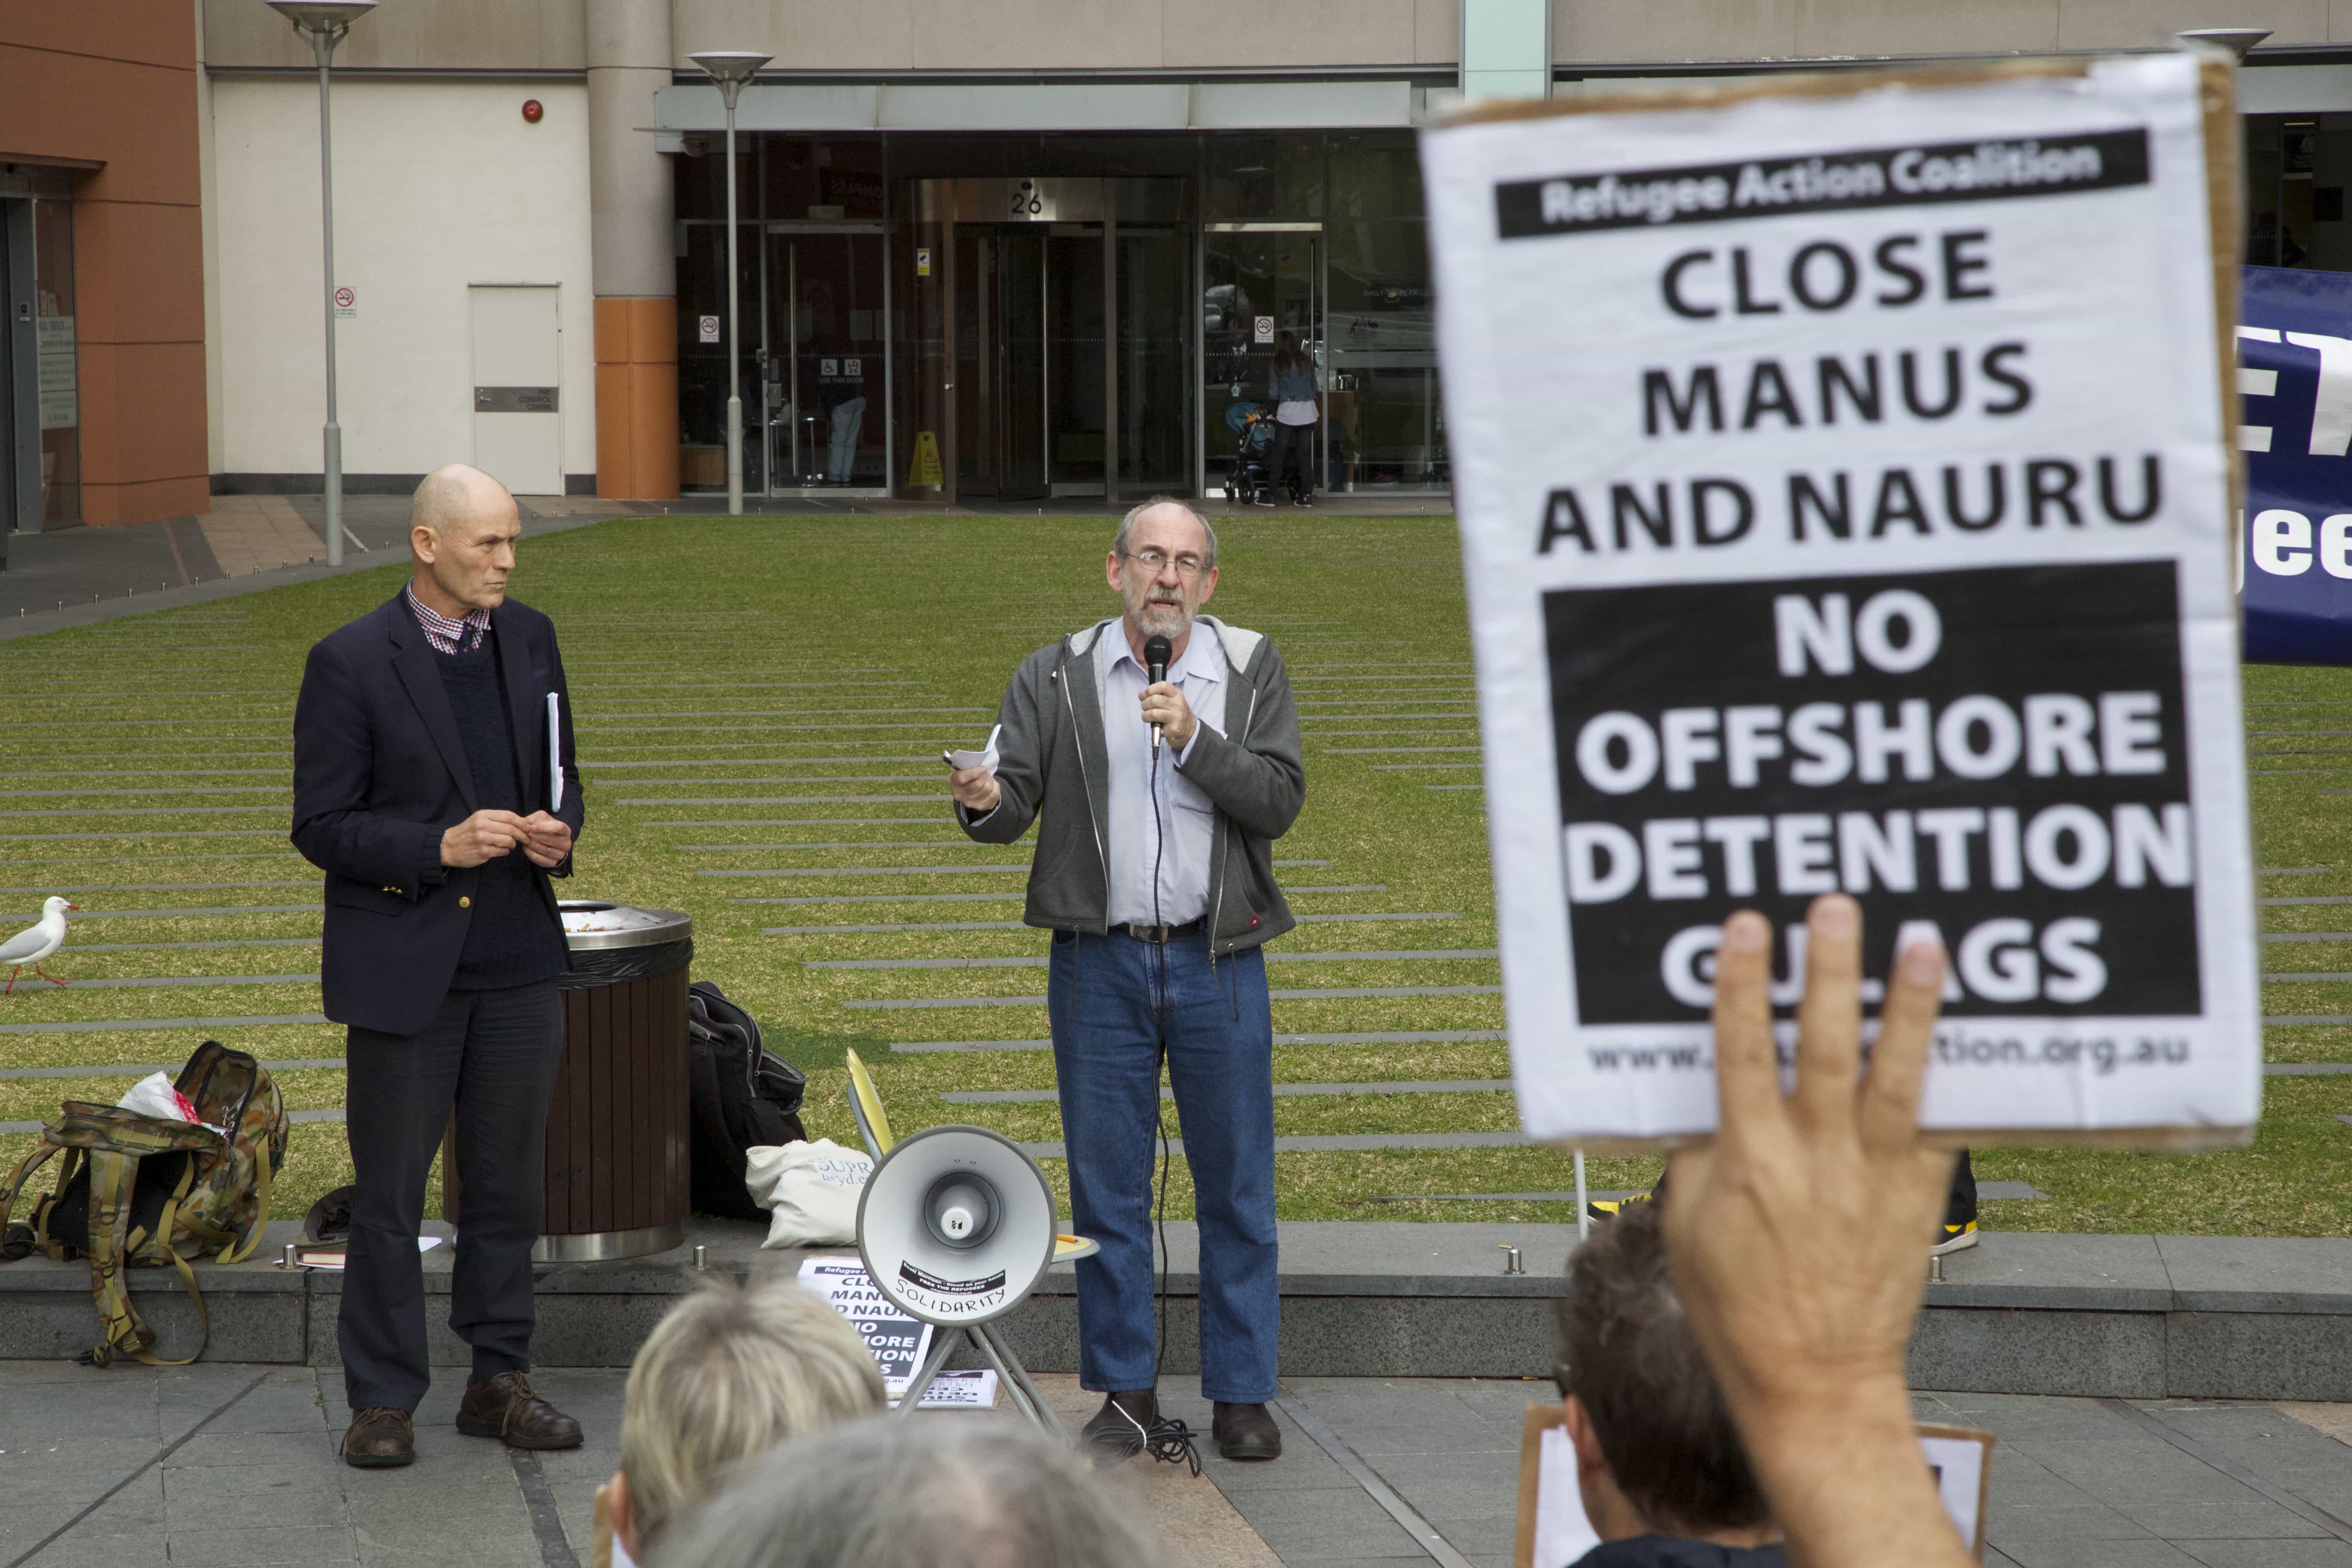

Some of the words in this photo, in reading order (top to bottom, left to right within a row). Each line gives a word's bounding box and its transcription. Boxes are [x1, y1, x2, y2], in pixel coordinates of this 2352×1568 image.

[1012, 194, 1042, 214] 26
[1541, 172, 1730, 224] Refugee
[1732, 157, 1886, 208] Action
[1889, 140, 2103, 194] Coalition
[1660, 230, 1995, 321] CLOSE
[1642, 342, 2034, 439] MANUS
[1536, 477, 1757, 556] AND
[1788, 453, 2163, 543] NAURU
[1775, 588, 1942, 677] NO
[1575, 690, 2167, 795] OFFSHORE
[1565, 803, 2196, 904] DETENTION
[895, 1279, 1004, 1313] SOLIDARITY
[904, 1262, 917, 1274] Scott
[918, 1271, 942, 1285] Morrison
[988, 1272, 1004, 1282] hands
[919, 1278, 935, 1287] FREE
